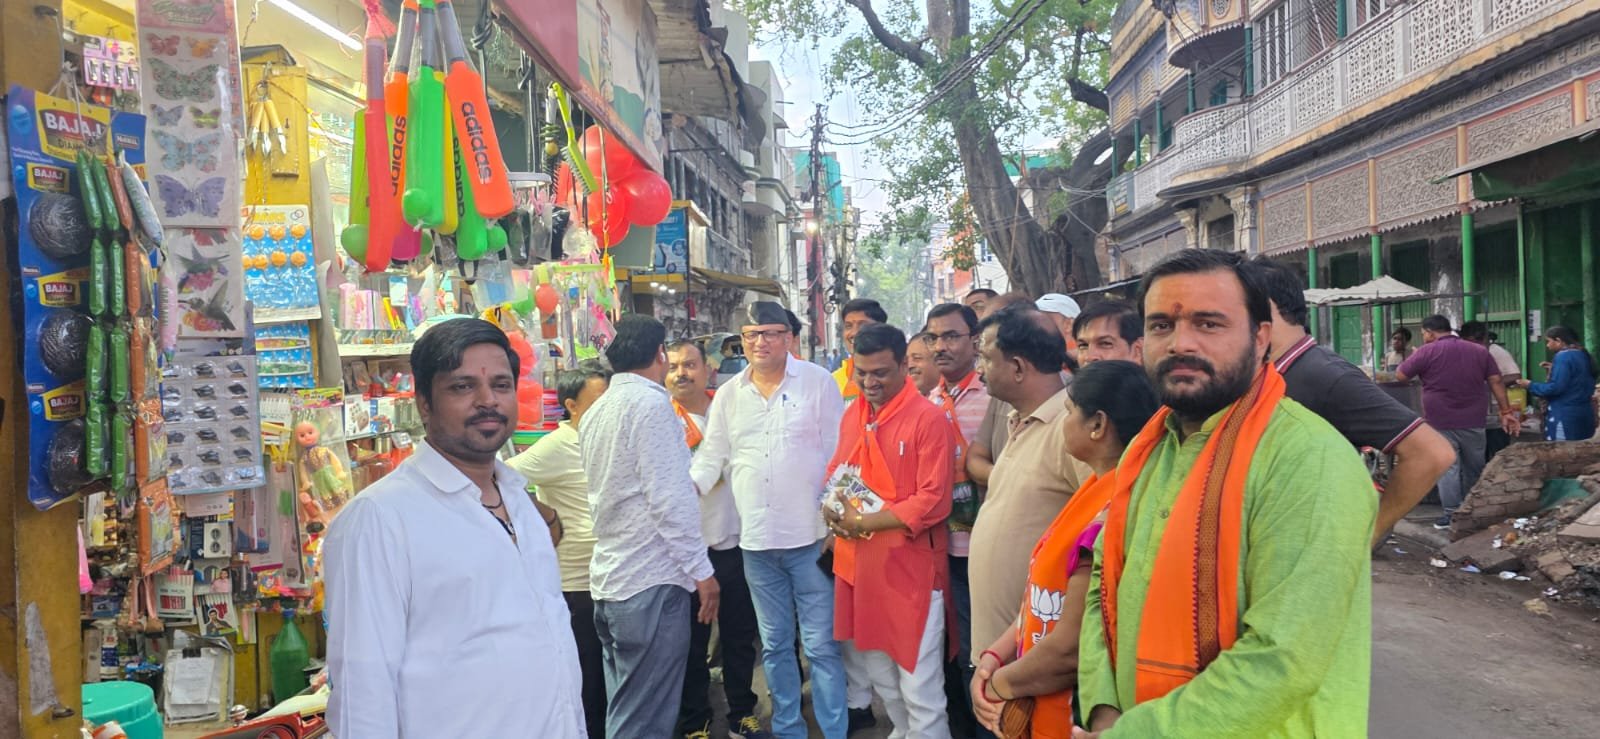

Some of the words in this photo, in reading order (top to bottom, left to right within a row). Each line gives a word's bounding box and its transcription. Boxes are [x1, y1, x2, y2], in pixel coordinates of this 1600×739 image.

[45, 112, 102, 138] BAJAJ
[462, 102, 491, 184] adidas
[34, 168, 62, 179] BAJAJ
[45, 283, 73, 293] BAJAJ
[51, 396, 79, 407] BAJAJ
